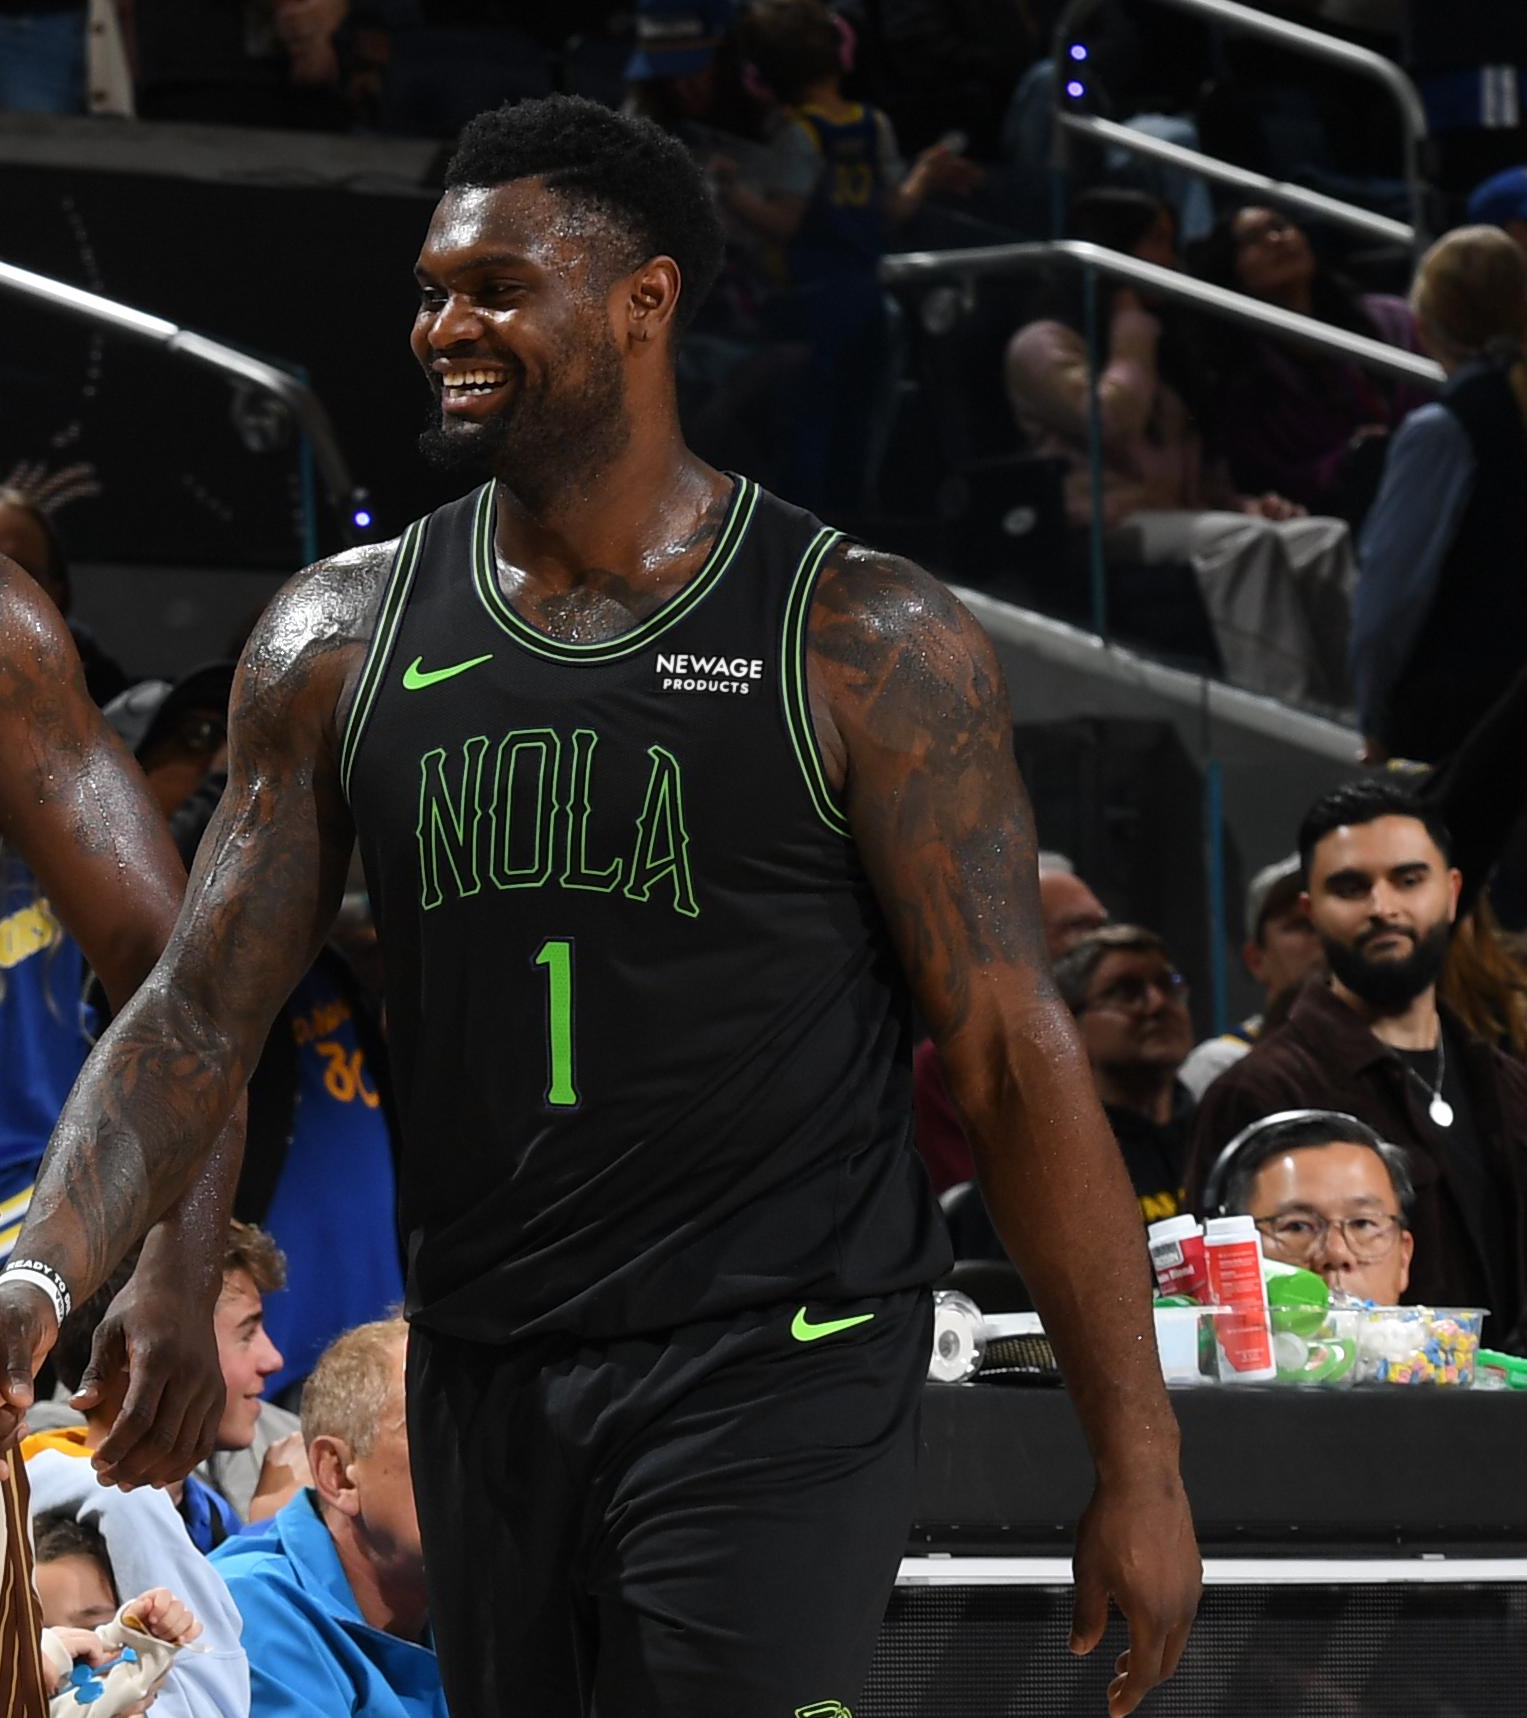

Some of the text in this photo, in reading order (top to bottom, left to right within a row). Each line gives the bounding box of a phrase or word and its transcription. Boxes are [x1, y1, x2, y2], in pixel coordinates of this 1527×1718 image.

[655, 653, 763, 679] NEWAGE
[662, 678, 750, 694] PRODUCTS
[416, 728, 701, 918] NOLA
[533, 937, 583, 1108] 1
[53, 1272, 67, 1293] TO
